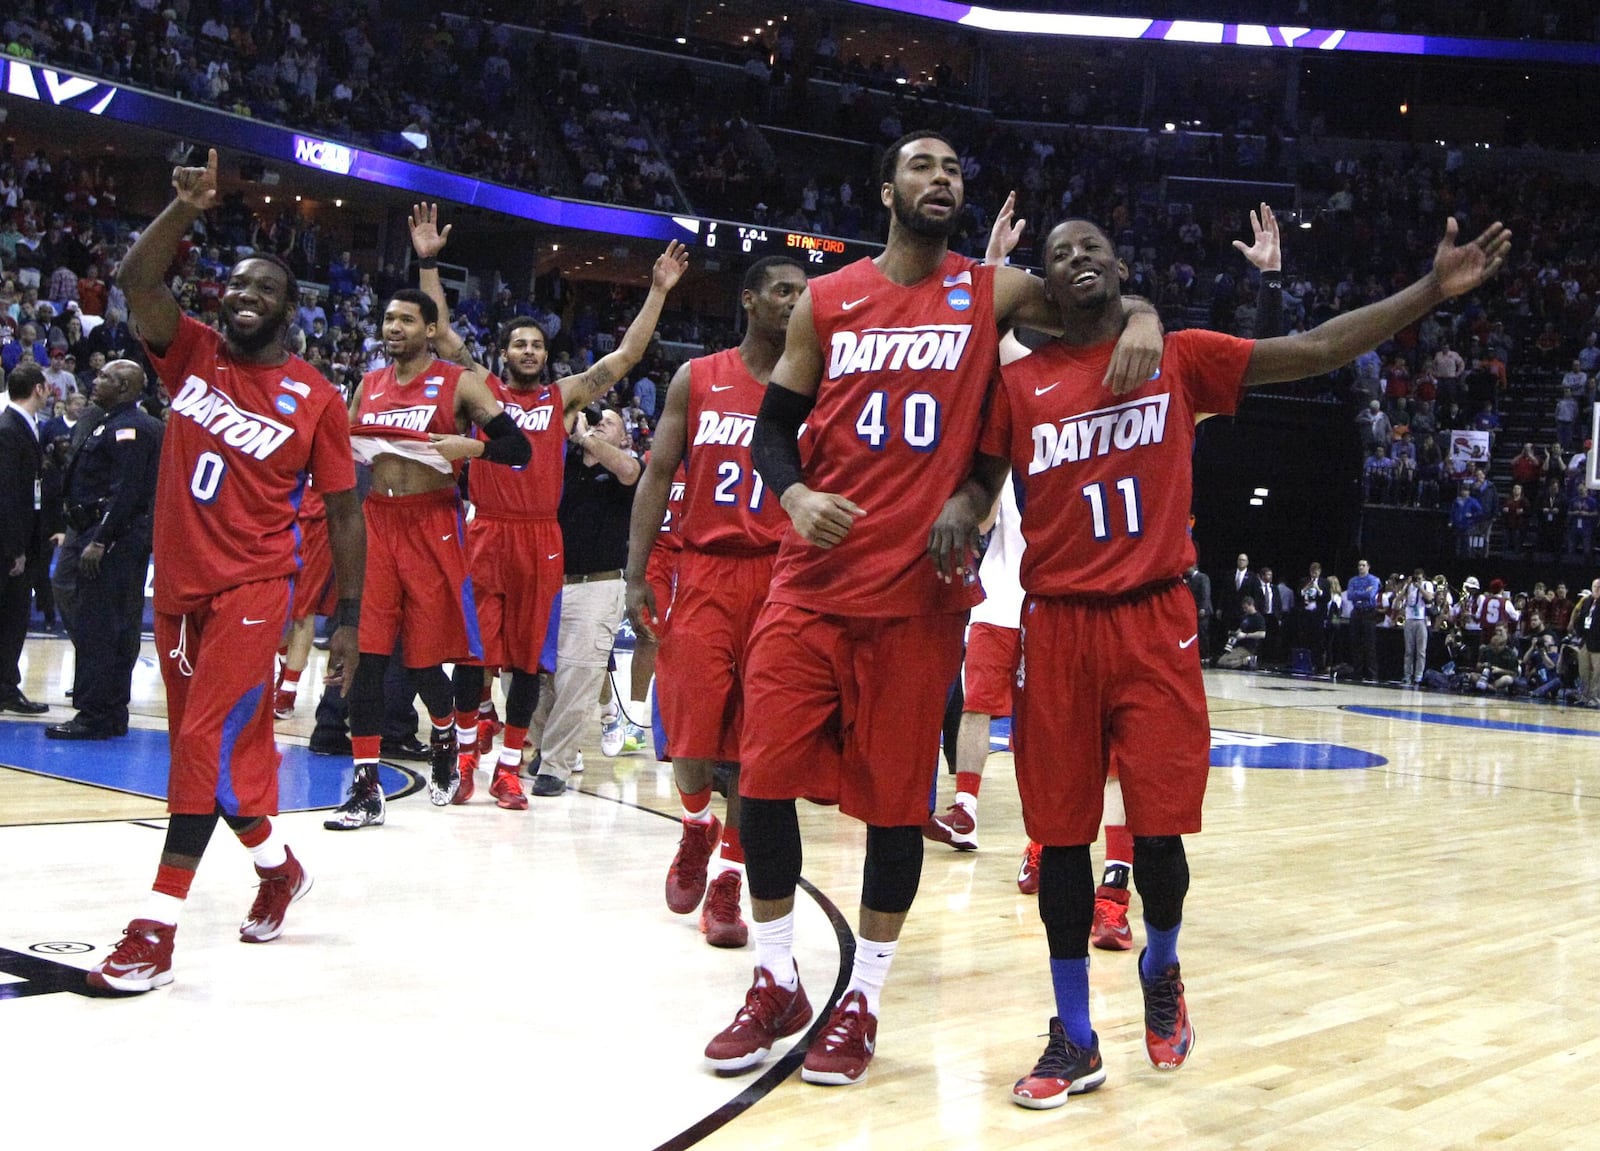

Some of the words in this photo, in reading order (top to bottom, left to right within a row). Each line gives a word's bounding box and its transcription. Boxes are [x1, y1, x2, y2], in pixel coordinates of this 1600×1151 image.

[707, 234, 716, 247] 0
[742, 239, 752, 252] 0
[787, 234, 845, 253] STANFORD
[808, 250, 823, 263] 72
[828, 324, 972, 380] DAYTON
[171, 374, 295, 460] DAYTON
[856, 391, 938, 448] 40
[1028, 392, 1170, 476] DAYTON
[190, 451, 226, 504] 0
[714, 461, 764, 511] 21
[1082, 477, 1141, 538] 11
[1486, 598, 1500, 624] S
